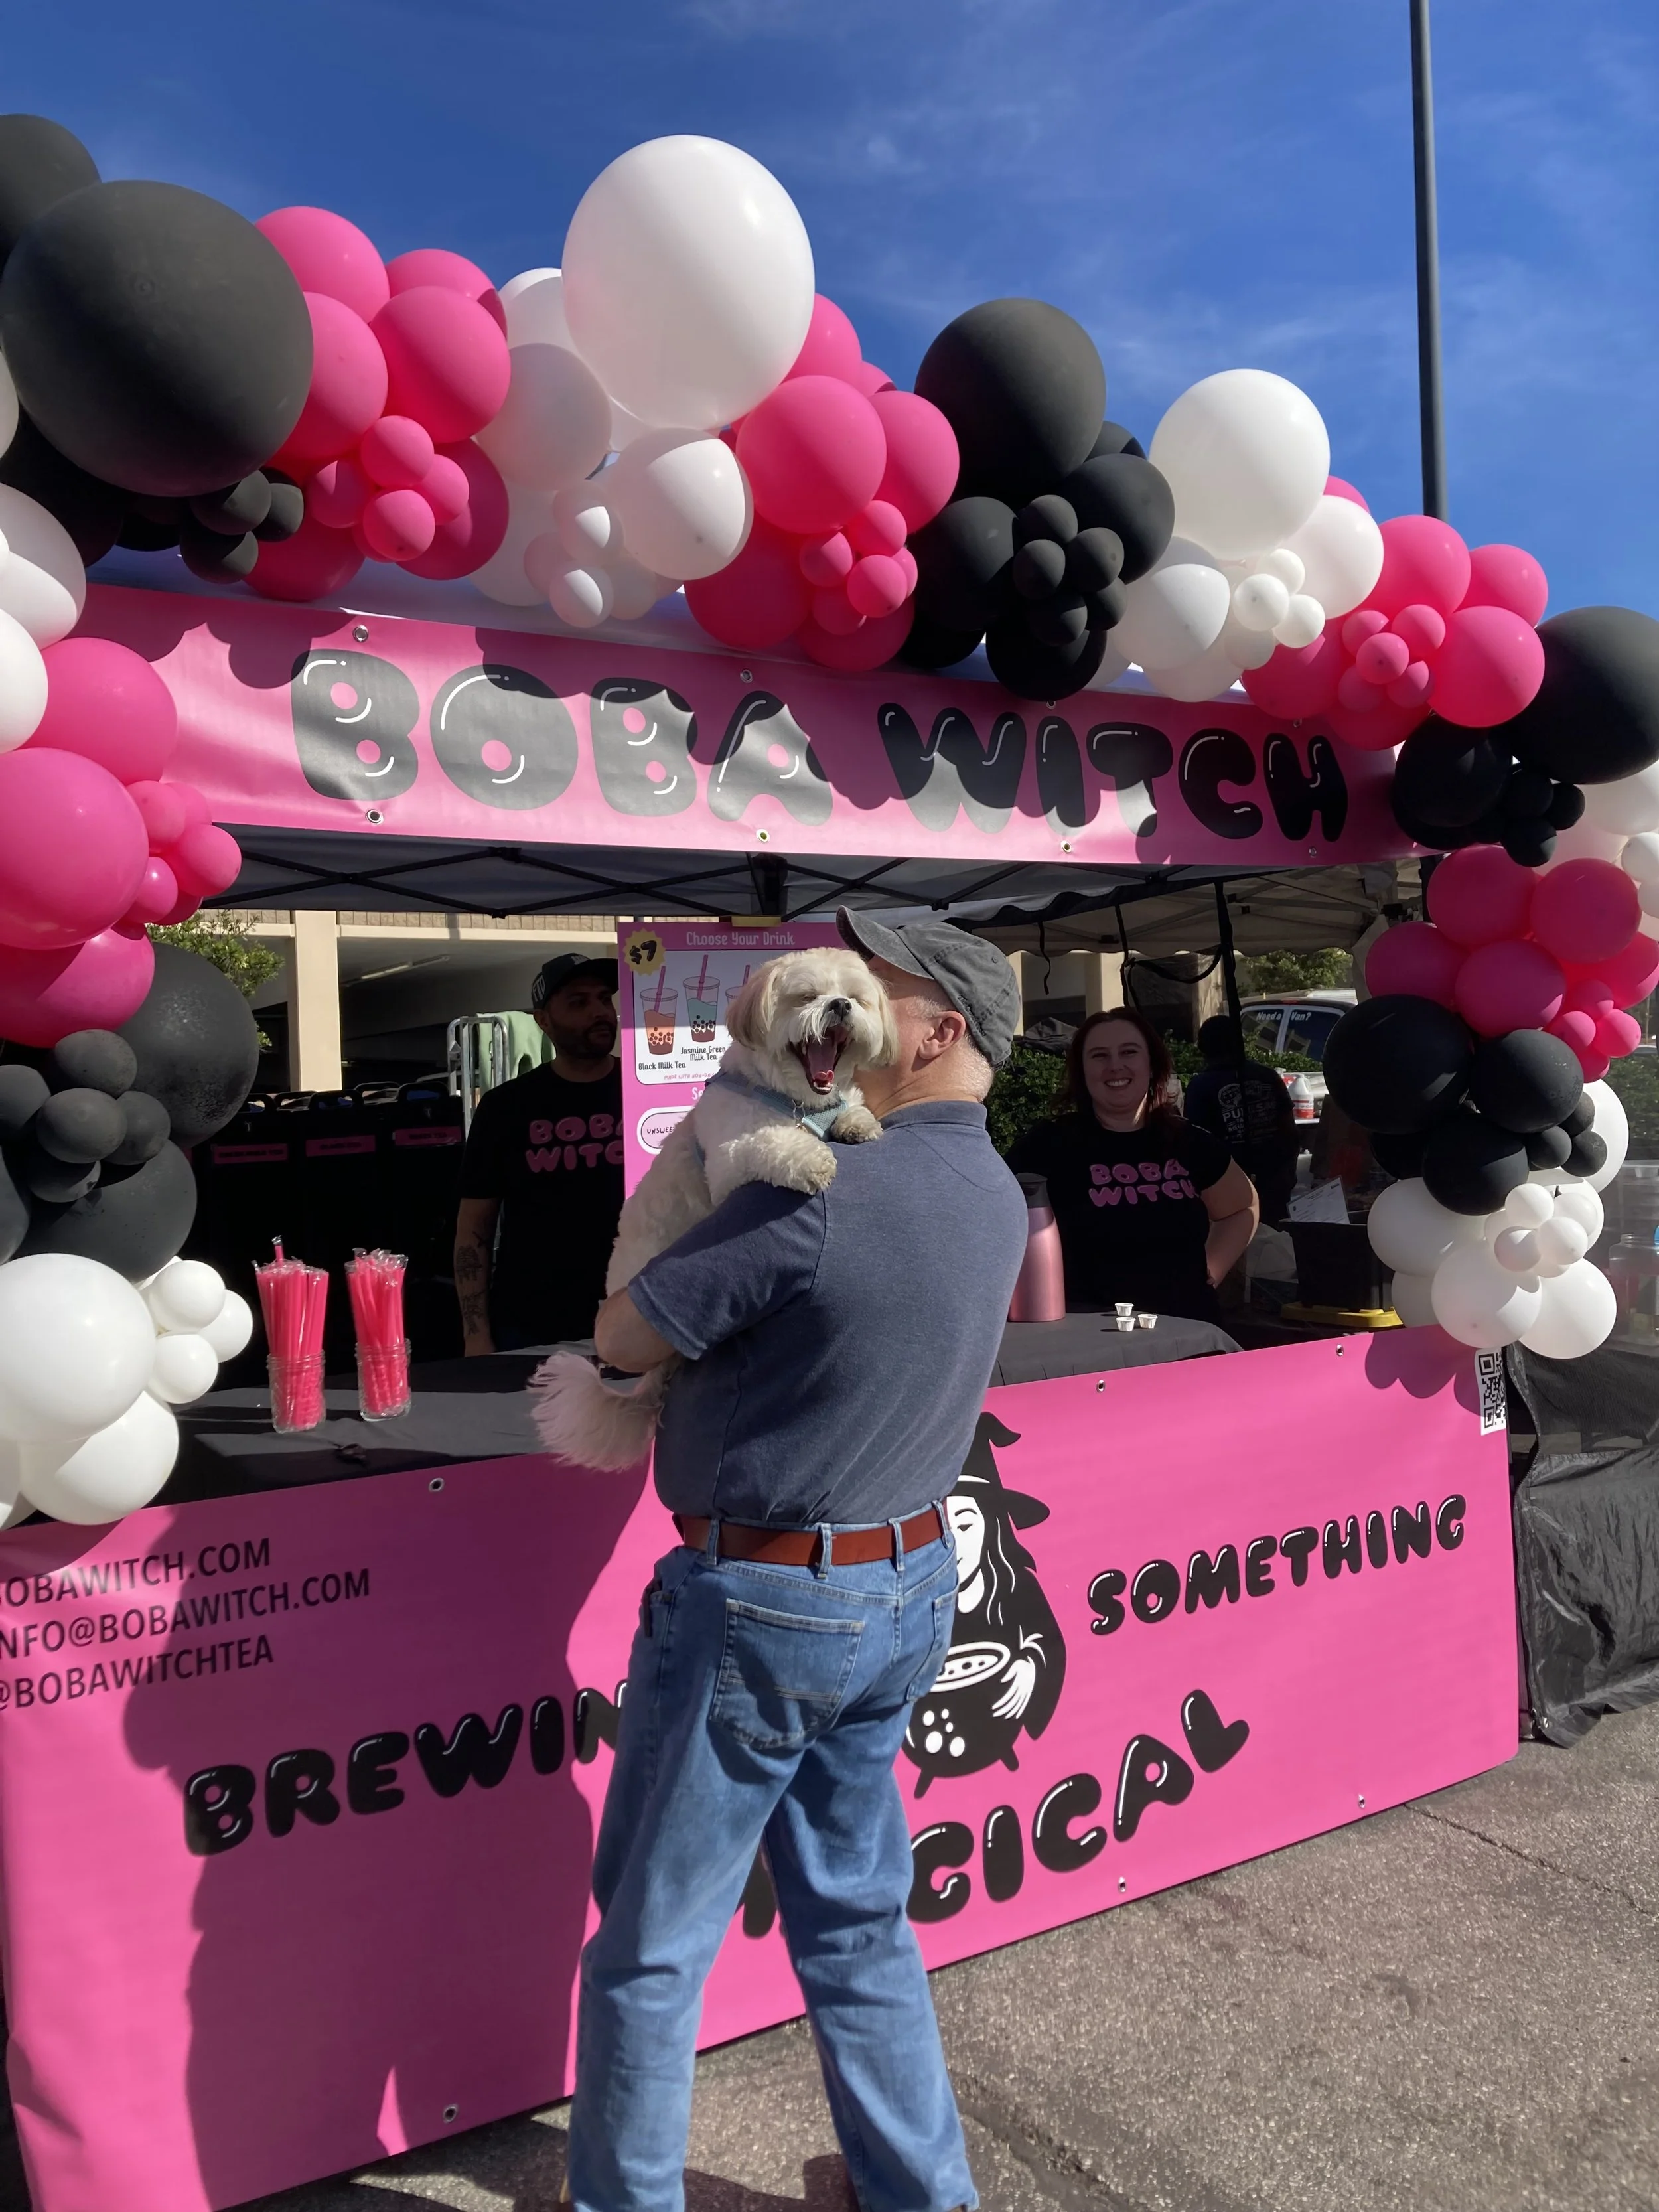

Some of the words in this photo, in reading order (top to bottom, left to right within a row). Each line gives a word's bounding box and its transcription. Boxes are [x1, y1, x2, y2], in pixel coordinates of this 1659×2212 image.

[291, 648, 834, 826] BOBA
[877, 702, 1348, 843] WITCH
[630, 940, 657, 964] $7
[686, 932, 728, 946] Choose
[731, 932, 759, 945] Your
[764, 931, 796, 946] Drink
[1256, 1012, 1276, 1021] Need
[1290, 1012, 1312, 1021] Van?
[526, 1140, 624, 1173] WITC
[1090, 1158, 1189, 1185] BOBA
[0, 1538, 271, 1608] OBAWITCH.COM
[1087, 1494, 1467, 1635] SOMETHING
[0, 1568, 370, 1659] NFO@BOBAWITCH.COM
[184, 1679, 628, 1856] BREWIN
